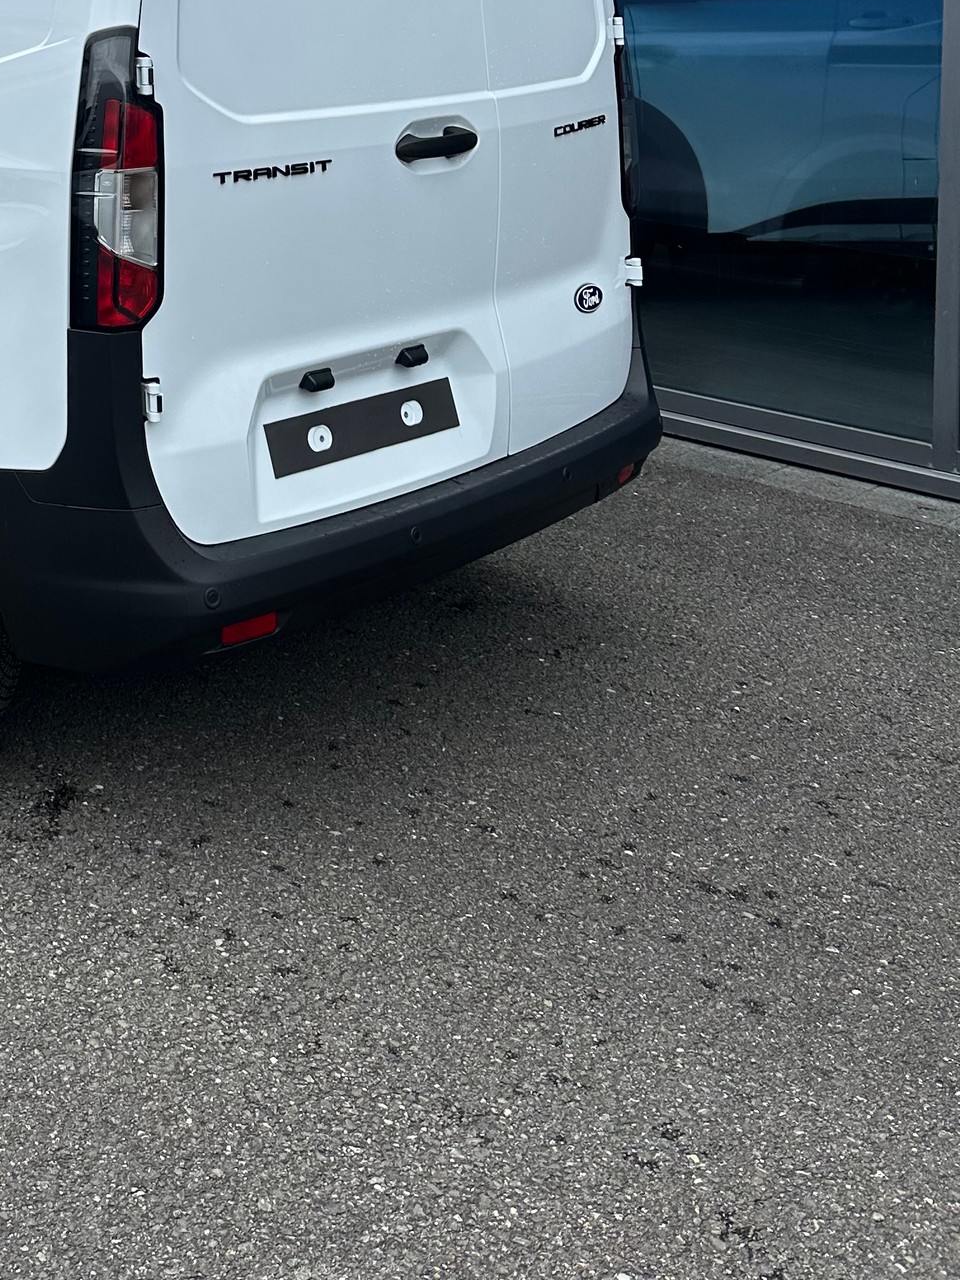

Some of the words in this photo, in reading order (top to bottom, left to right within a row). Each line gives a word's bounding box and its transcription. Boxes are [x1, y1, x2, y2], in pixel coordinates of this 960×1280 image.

[553, 114, 606, 138] COURIER
[212, 159, 333, 185] TRANSIT
[581, 287, 601, 309] Ford
